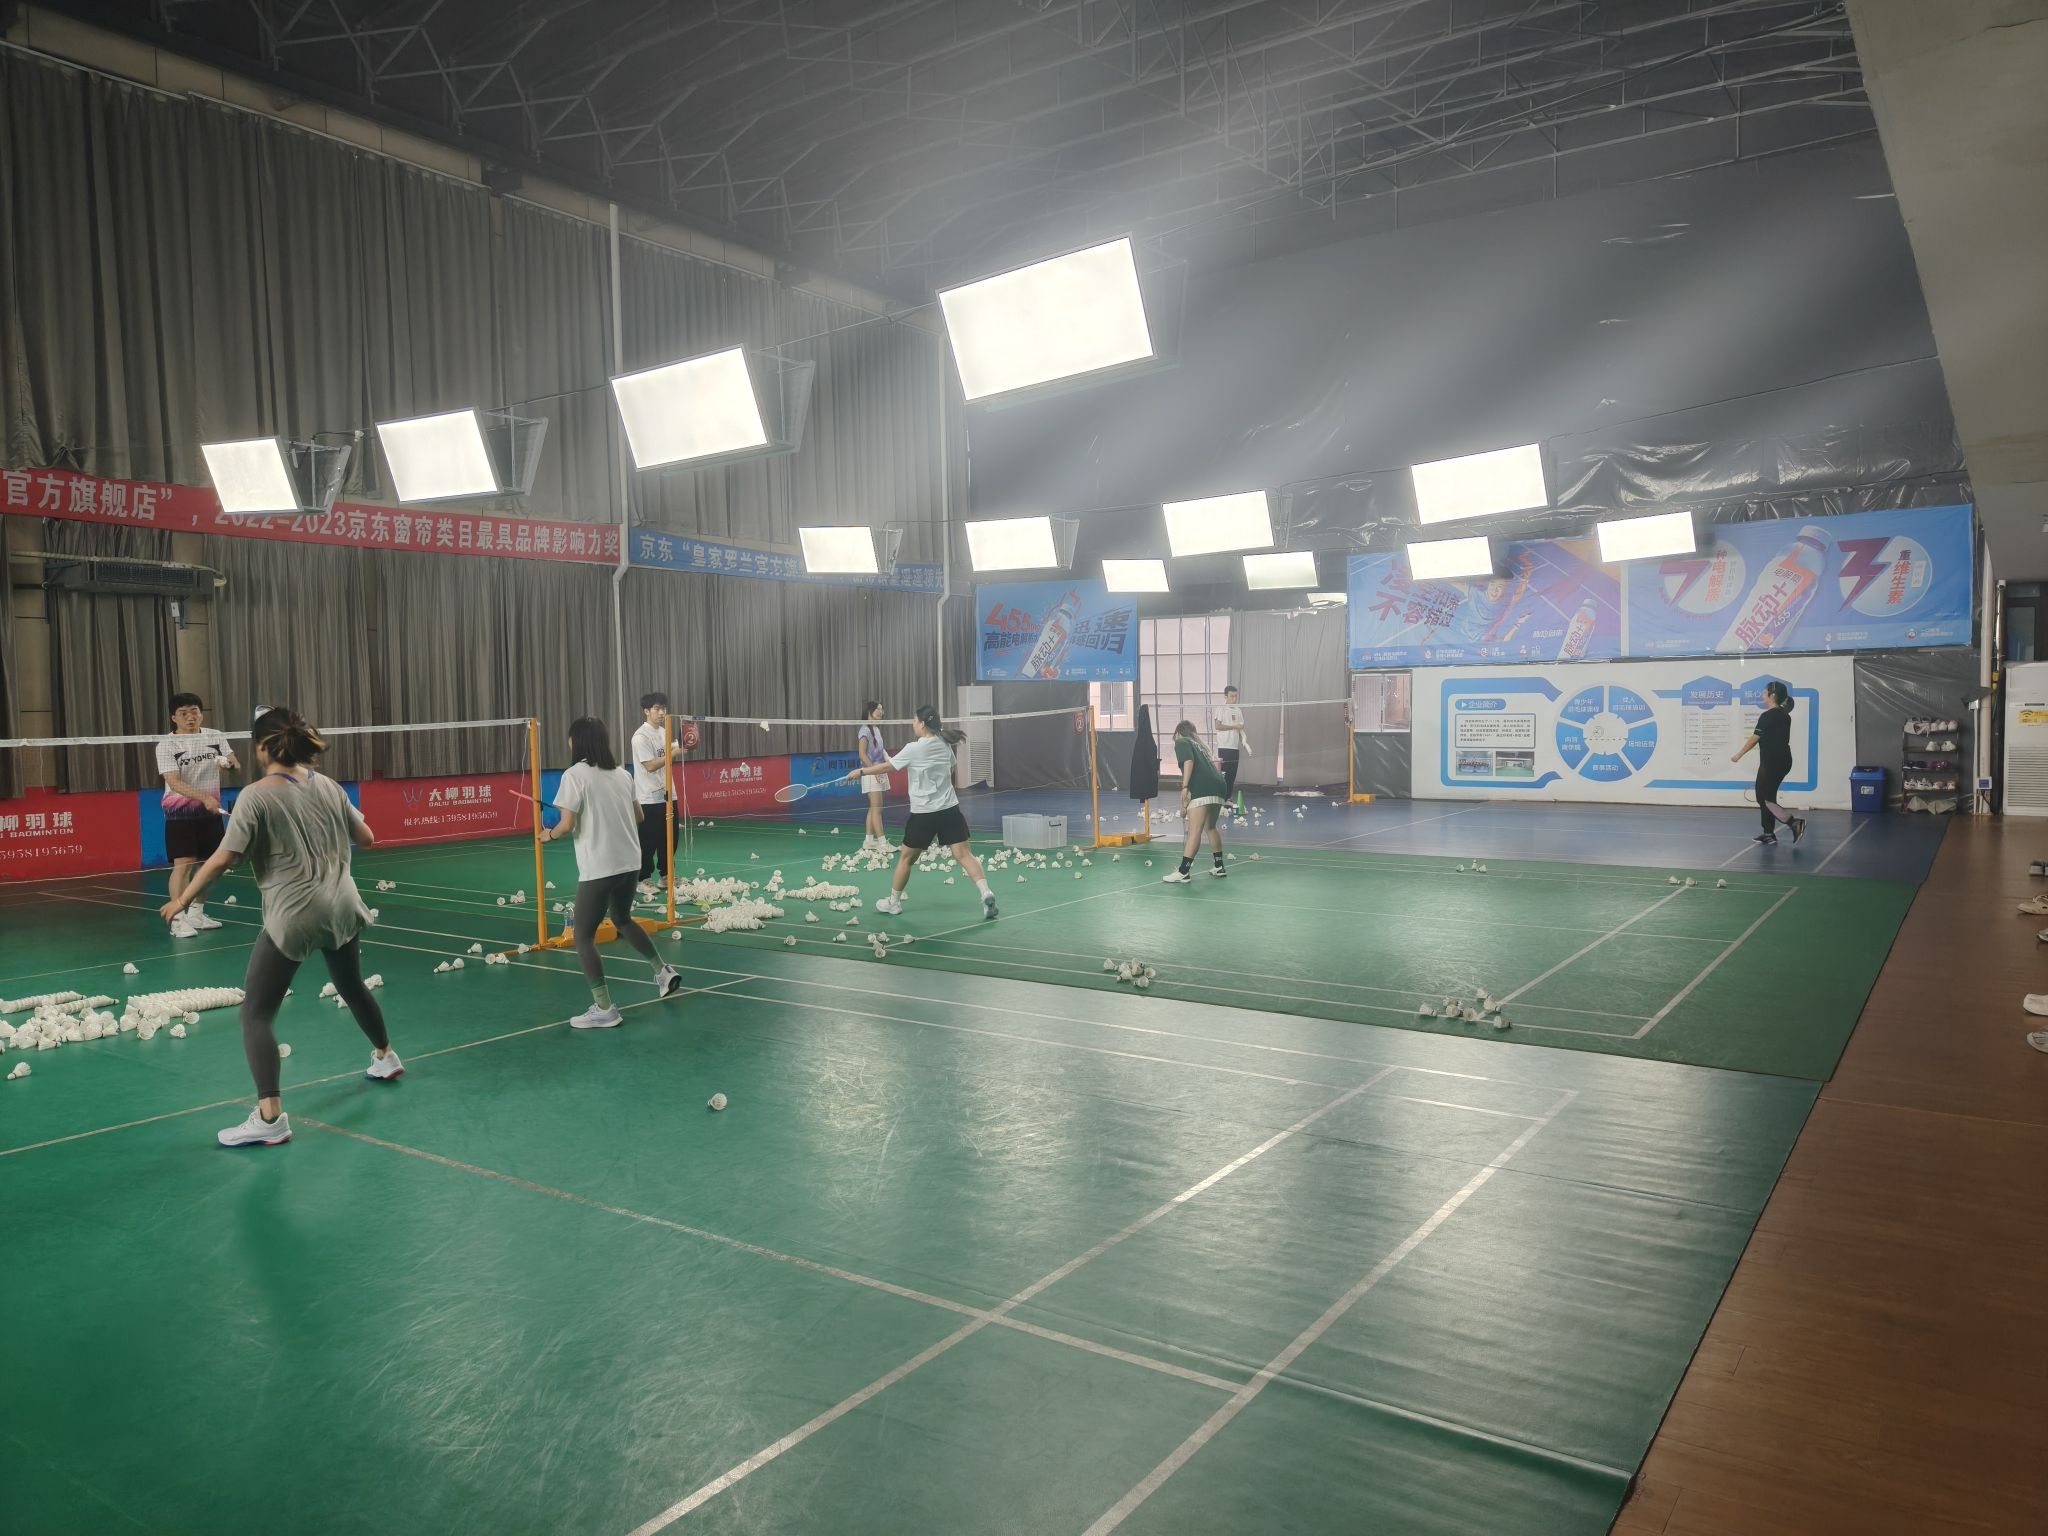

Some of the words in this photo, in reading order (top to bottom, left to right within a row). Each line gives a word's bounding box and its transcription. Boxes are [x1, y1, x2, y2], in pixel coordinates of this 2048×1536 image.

[429, 784, 492, 802] 大柳羽球
[10, 828, 74, 838] BADMINTON
